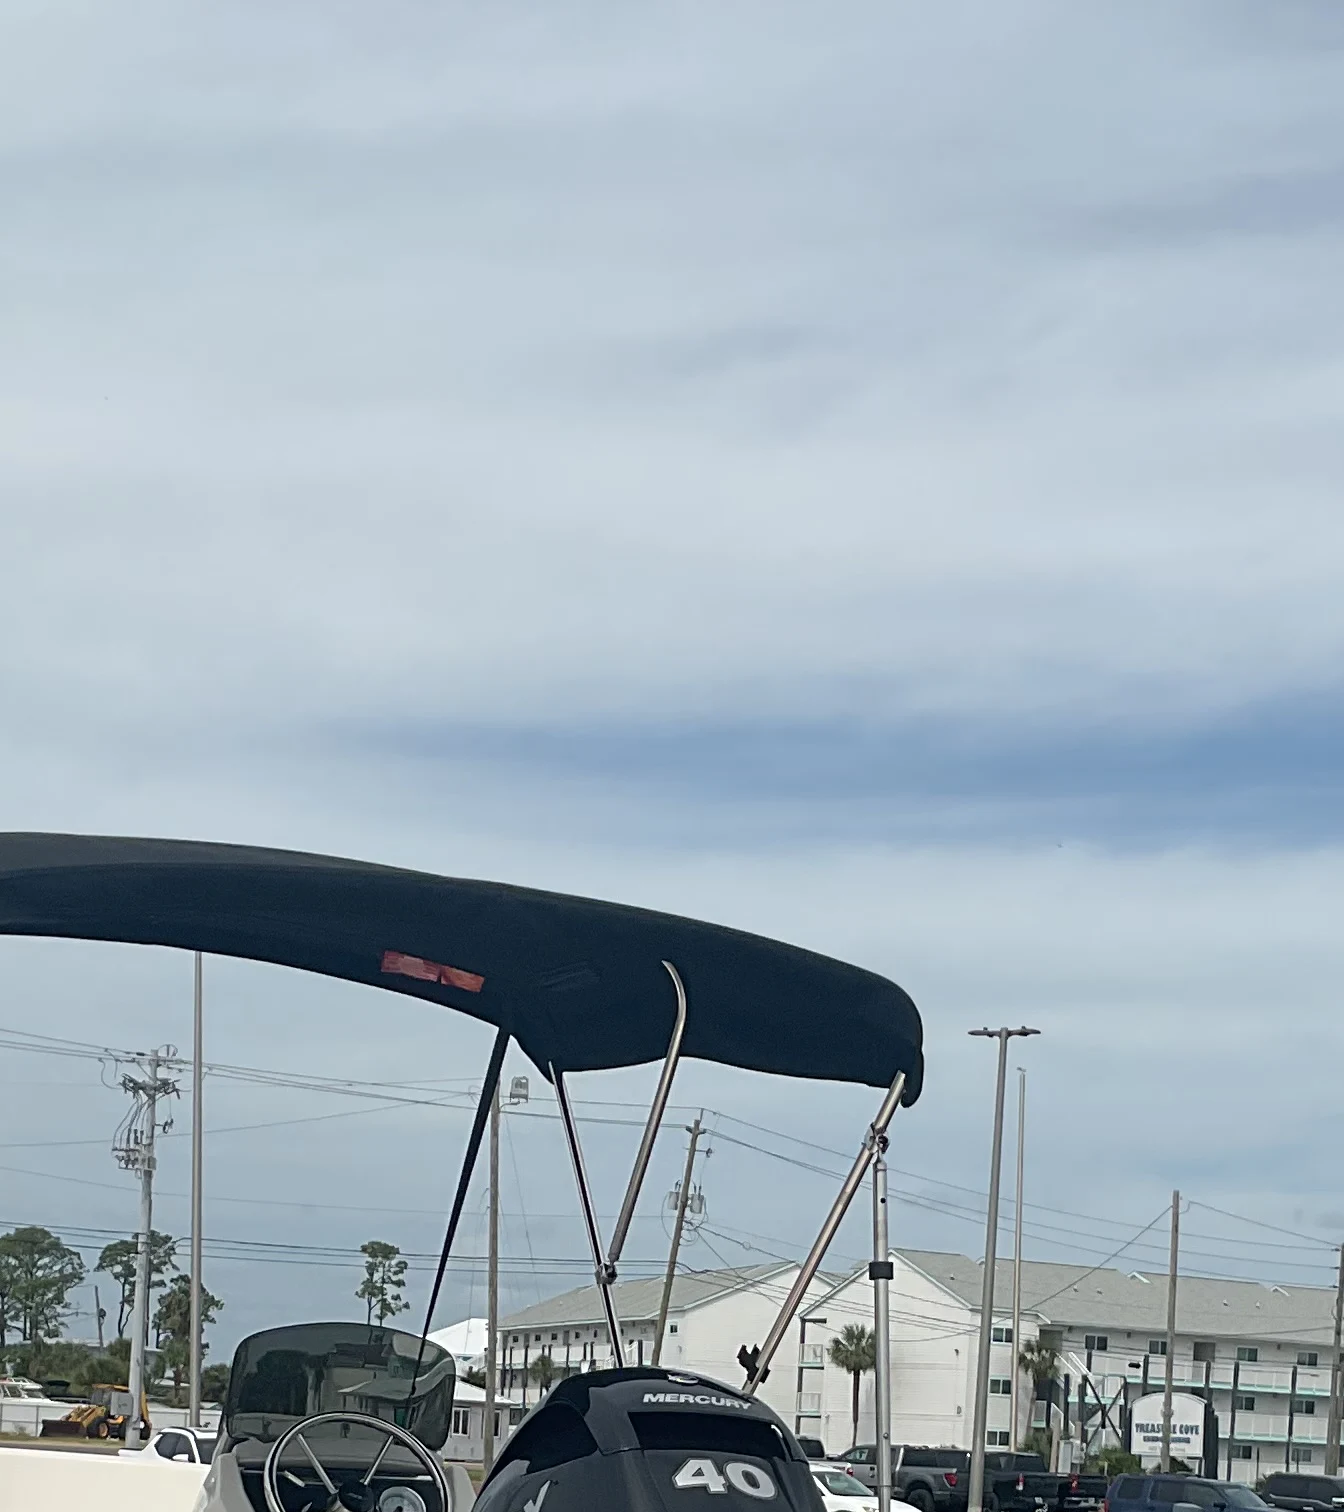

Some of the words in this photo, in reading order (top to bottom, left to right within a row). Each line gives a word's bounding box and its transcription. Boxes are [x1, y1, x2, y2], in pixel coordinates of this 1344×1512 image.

[643, 1393, 751, 1410] MERCURY
[1135, 1422, 1177, 1434] TREASE
[1179, 1423, 1200, 1435] COVE
[672, 1457, 778, 1500] 40
